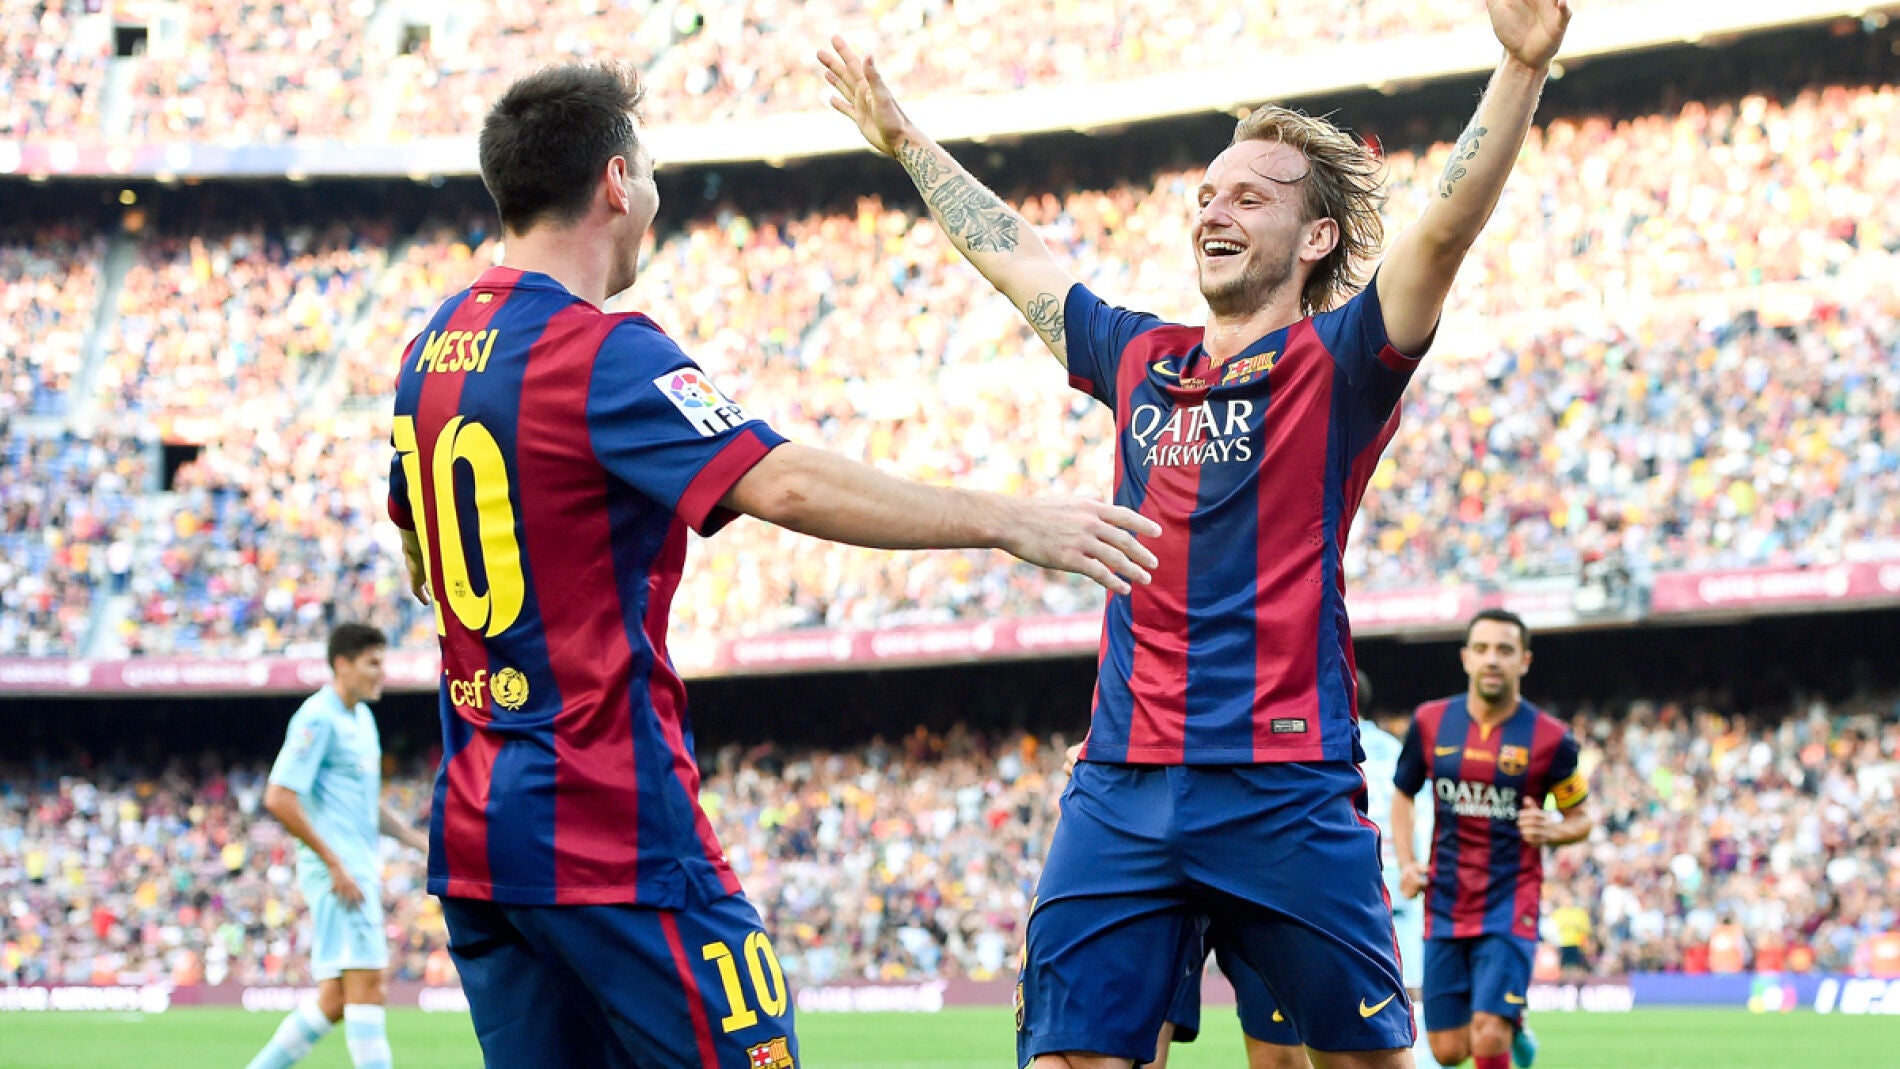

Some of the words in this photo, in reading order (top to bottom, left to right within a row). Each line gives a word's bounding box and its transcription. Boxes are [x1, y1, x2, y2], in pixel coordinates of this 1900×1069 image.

[415, 328, 499, 373] MESSI
[1131, 400, 1253, 448] QATAR
[1143, 436, 1252, 466] AIRWAYS
[393, 415, 525, 637] 10
[445, 669, 487, 708] cef
[702, 931, 787, 1033] 10
